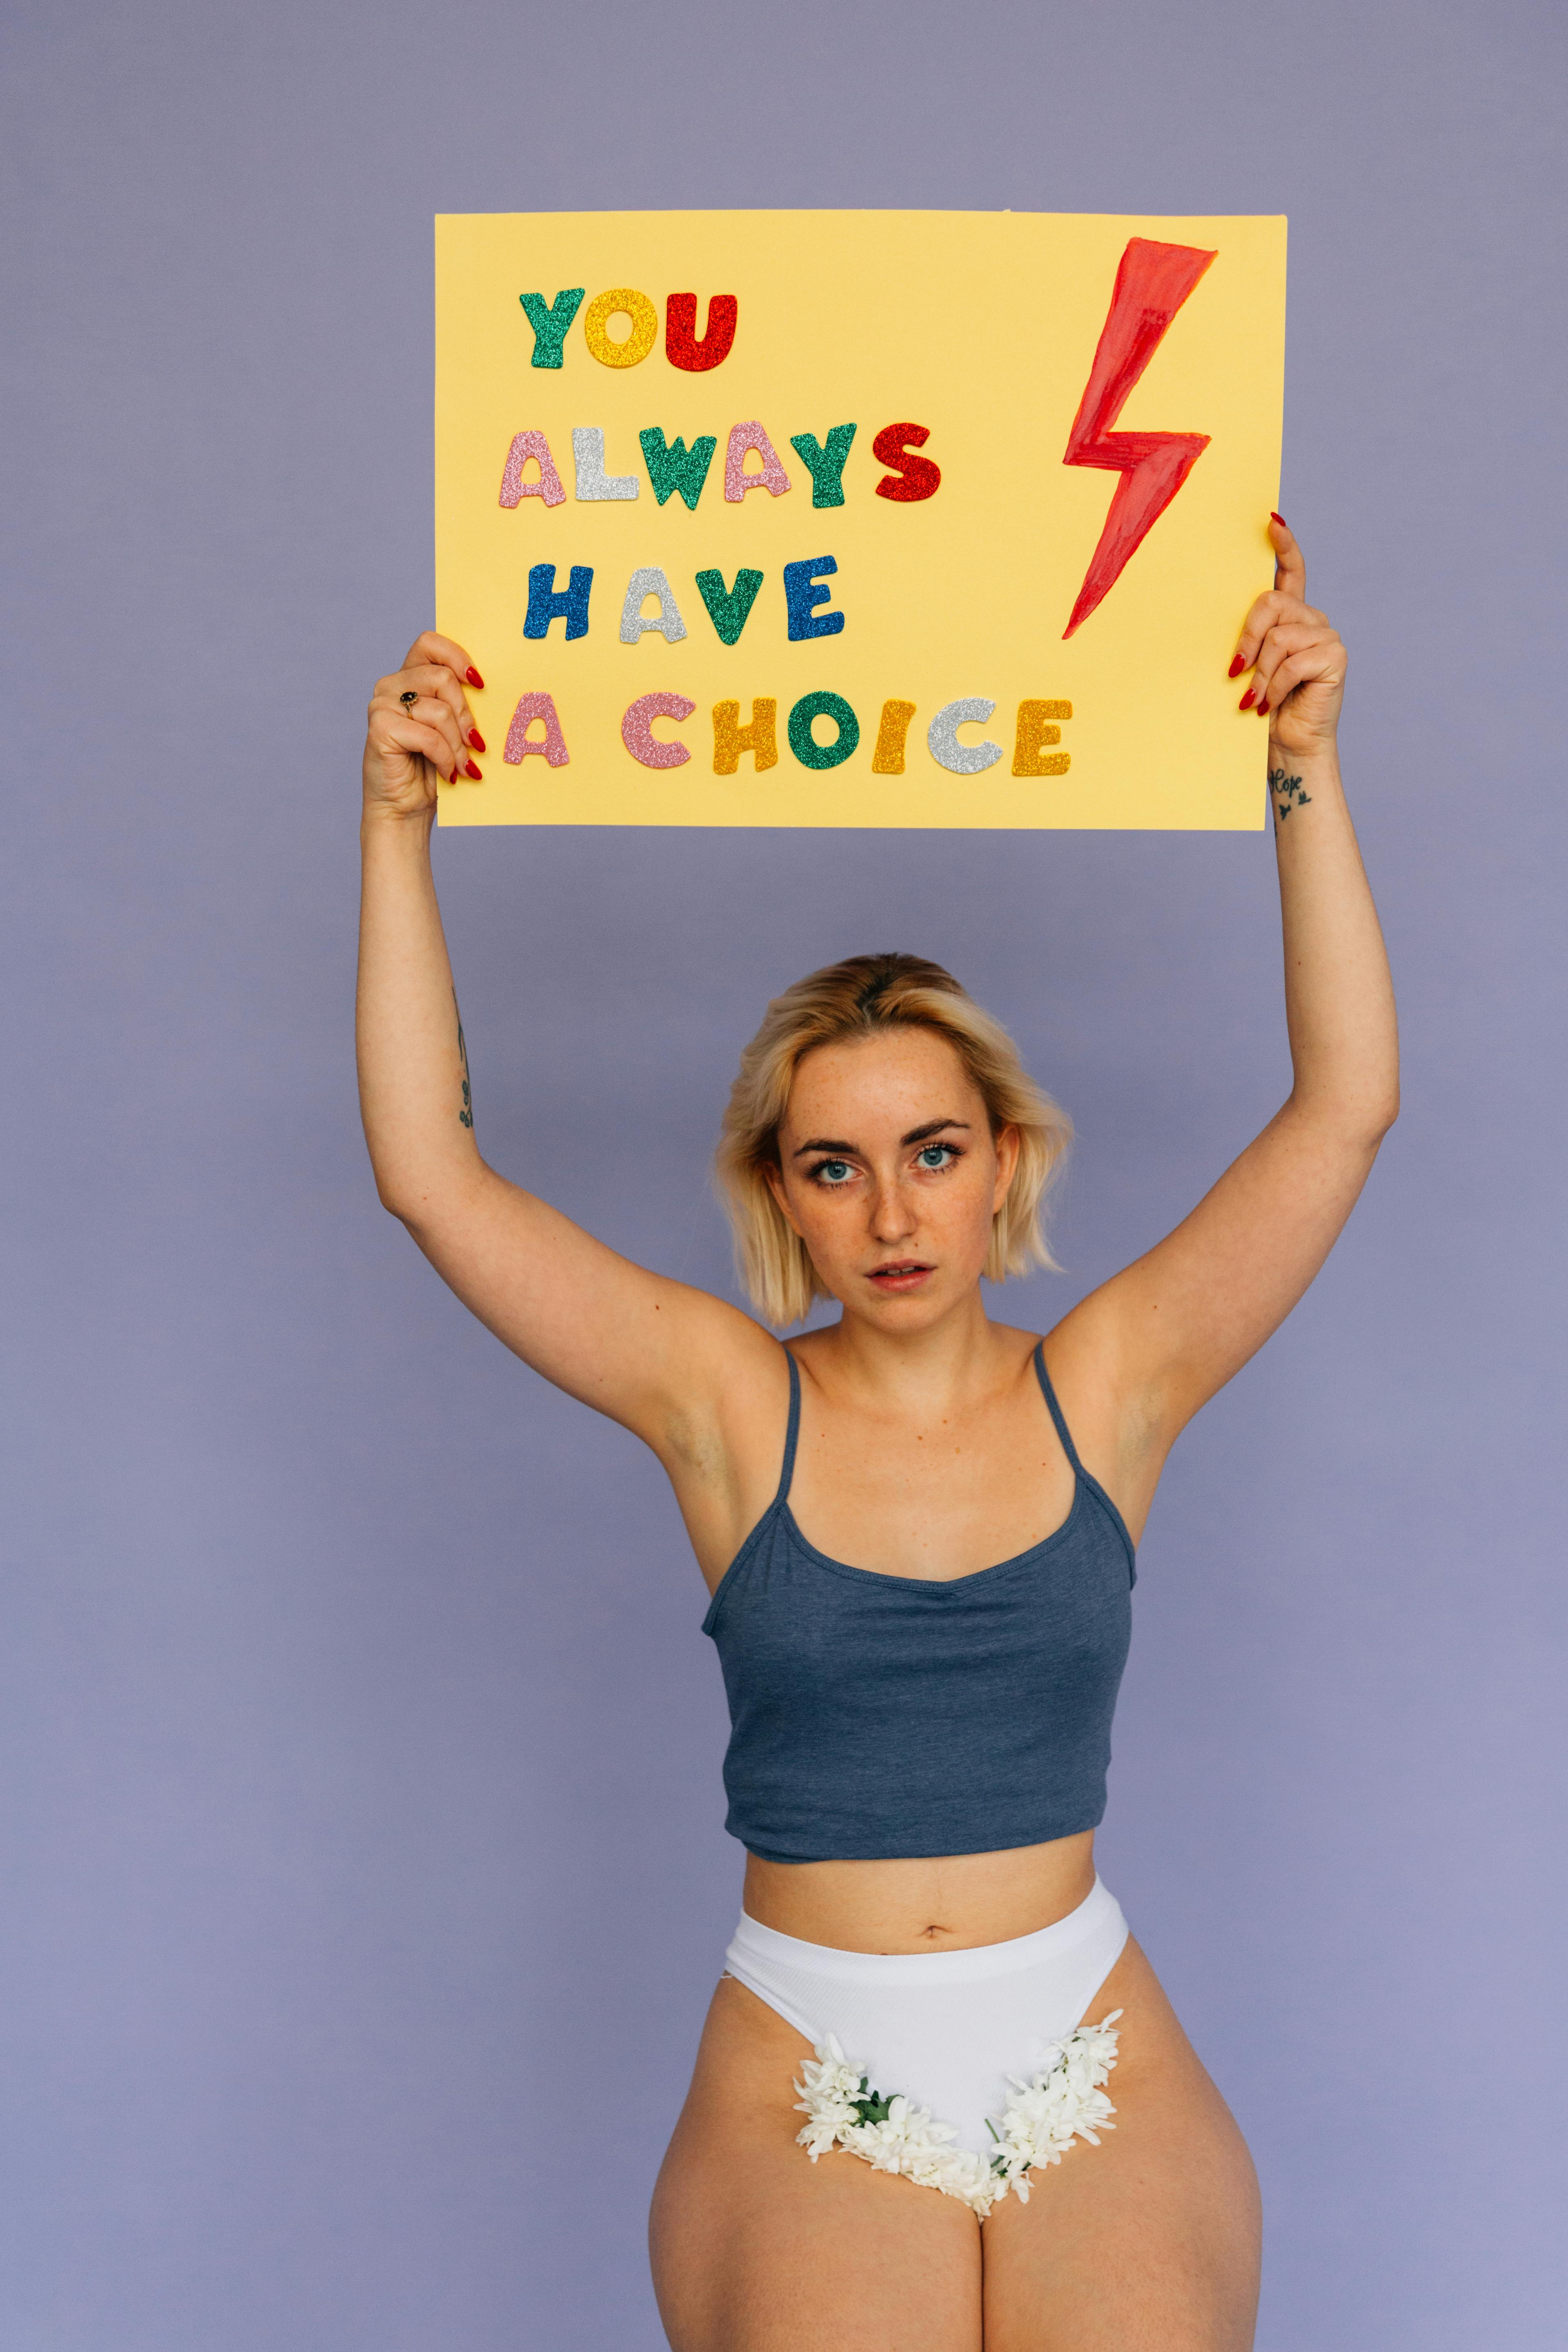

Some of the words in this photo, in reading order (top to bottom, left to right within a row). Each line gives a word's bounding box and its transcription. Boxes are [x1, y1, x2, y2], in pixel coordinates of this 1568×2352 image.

[519, 287, 737, 372] YOU
[499, 421, 941, 510] ALWAYS
[523, 555, 845, 645] HAVE
[503, 692, 570, 768] A
[621, 691, 1073, 777] CHOICE
[1270, 768, 1302, 798] Hope
